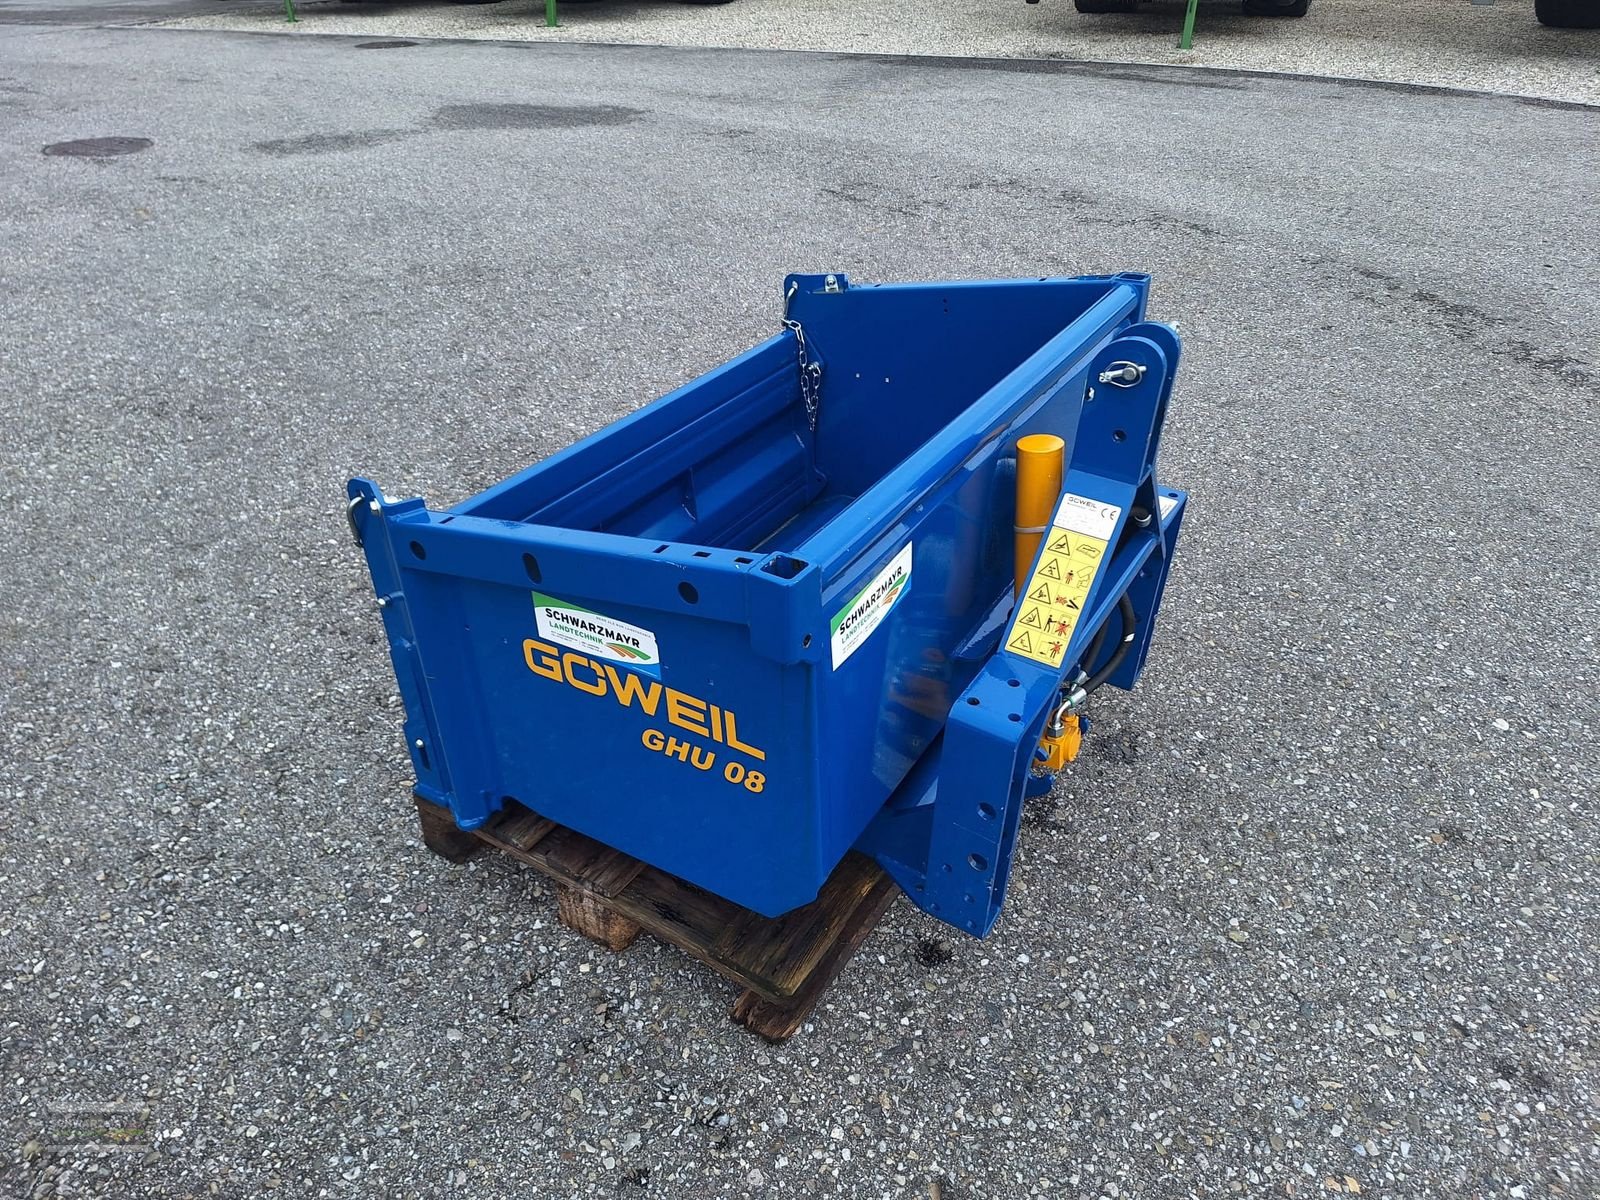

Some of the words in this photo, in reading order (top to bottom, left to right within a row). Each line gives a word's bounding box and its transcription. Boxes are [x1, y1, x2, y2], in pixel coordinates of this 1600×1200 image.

[839, 566, 902, 635] SCHWARZMAYR
[545, 607, 640, 648] SCHWARZMAYR
[549, 621, 604, 645] LANDTECHNIK
[641, 728, 716, 770] GHU
[724, 762, 766, 793] 08
